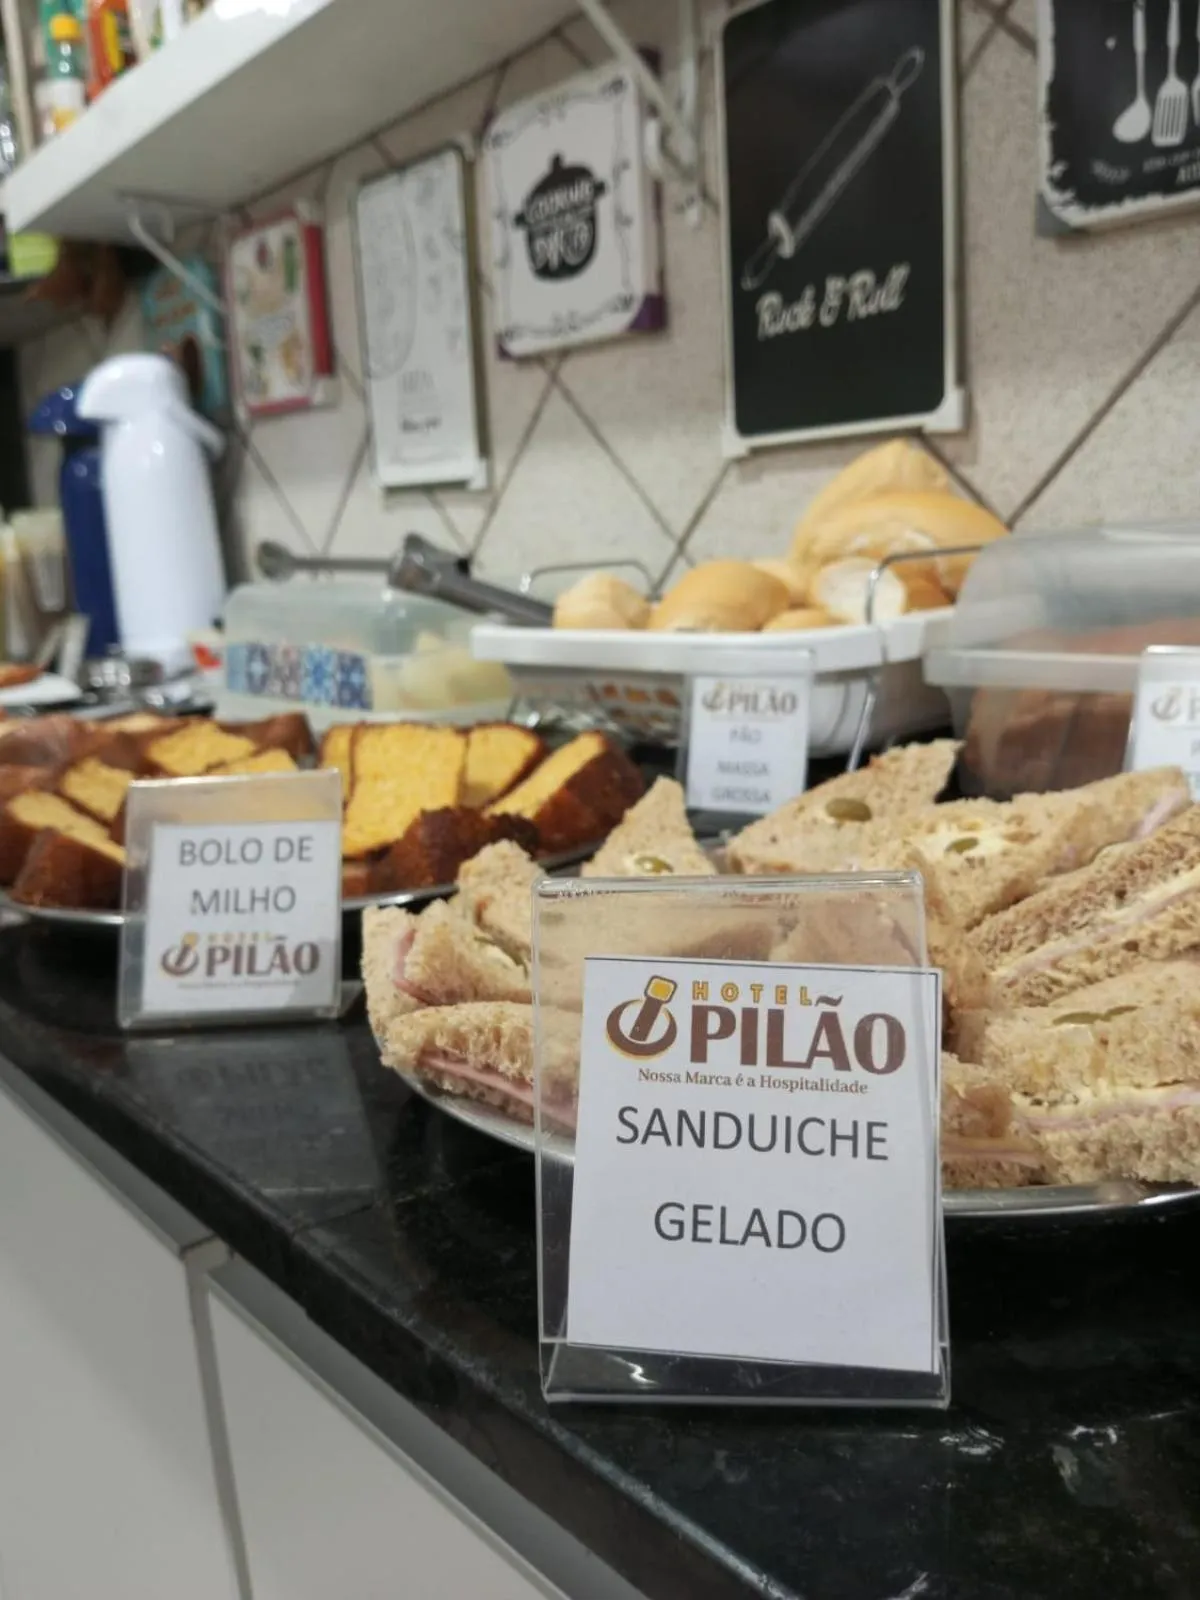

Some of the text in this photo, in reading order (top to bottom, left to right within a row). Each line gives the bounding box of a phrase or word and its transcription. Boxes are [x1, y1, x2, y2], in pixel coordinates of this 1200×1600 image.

[178, 836, 314, 867] BOLO DE
[190, 885, 297, 916] MILHO
[205, 935, 320, 977] PILÃO
[691, 980, 812, 1006] HOTEL
[690, 994, 907, 1075] PILÃO
[638, 1067, 868, 1094] Nossa Marca é a Hospitalidade
[615, 1106, 889, 1161] SANDUICHE
[653, 1202, 846, 1253] GELADO
